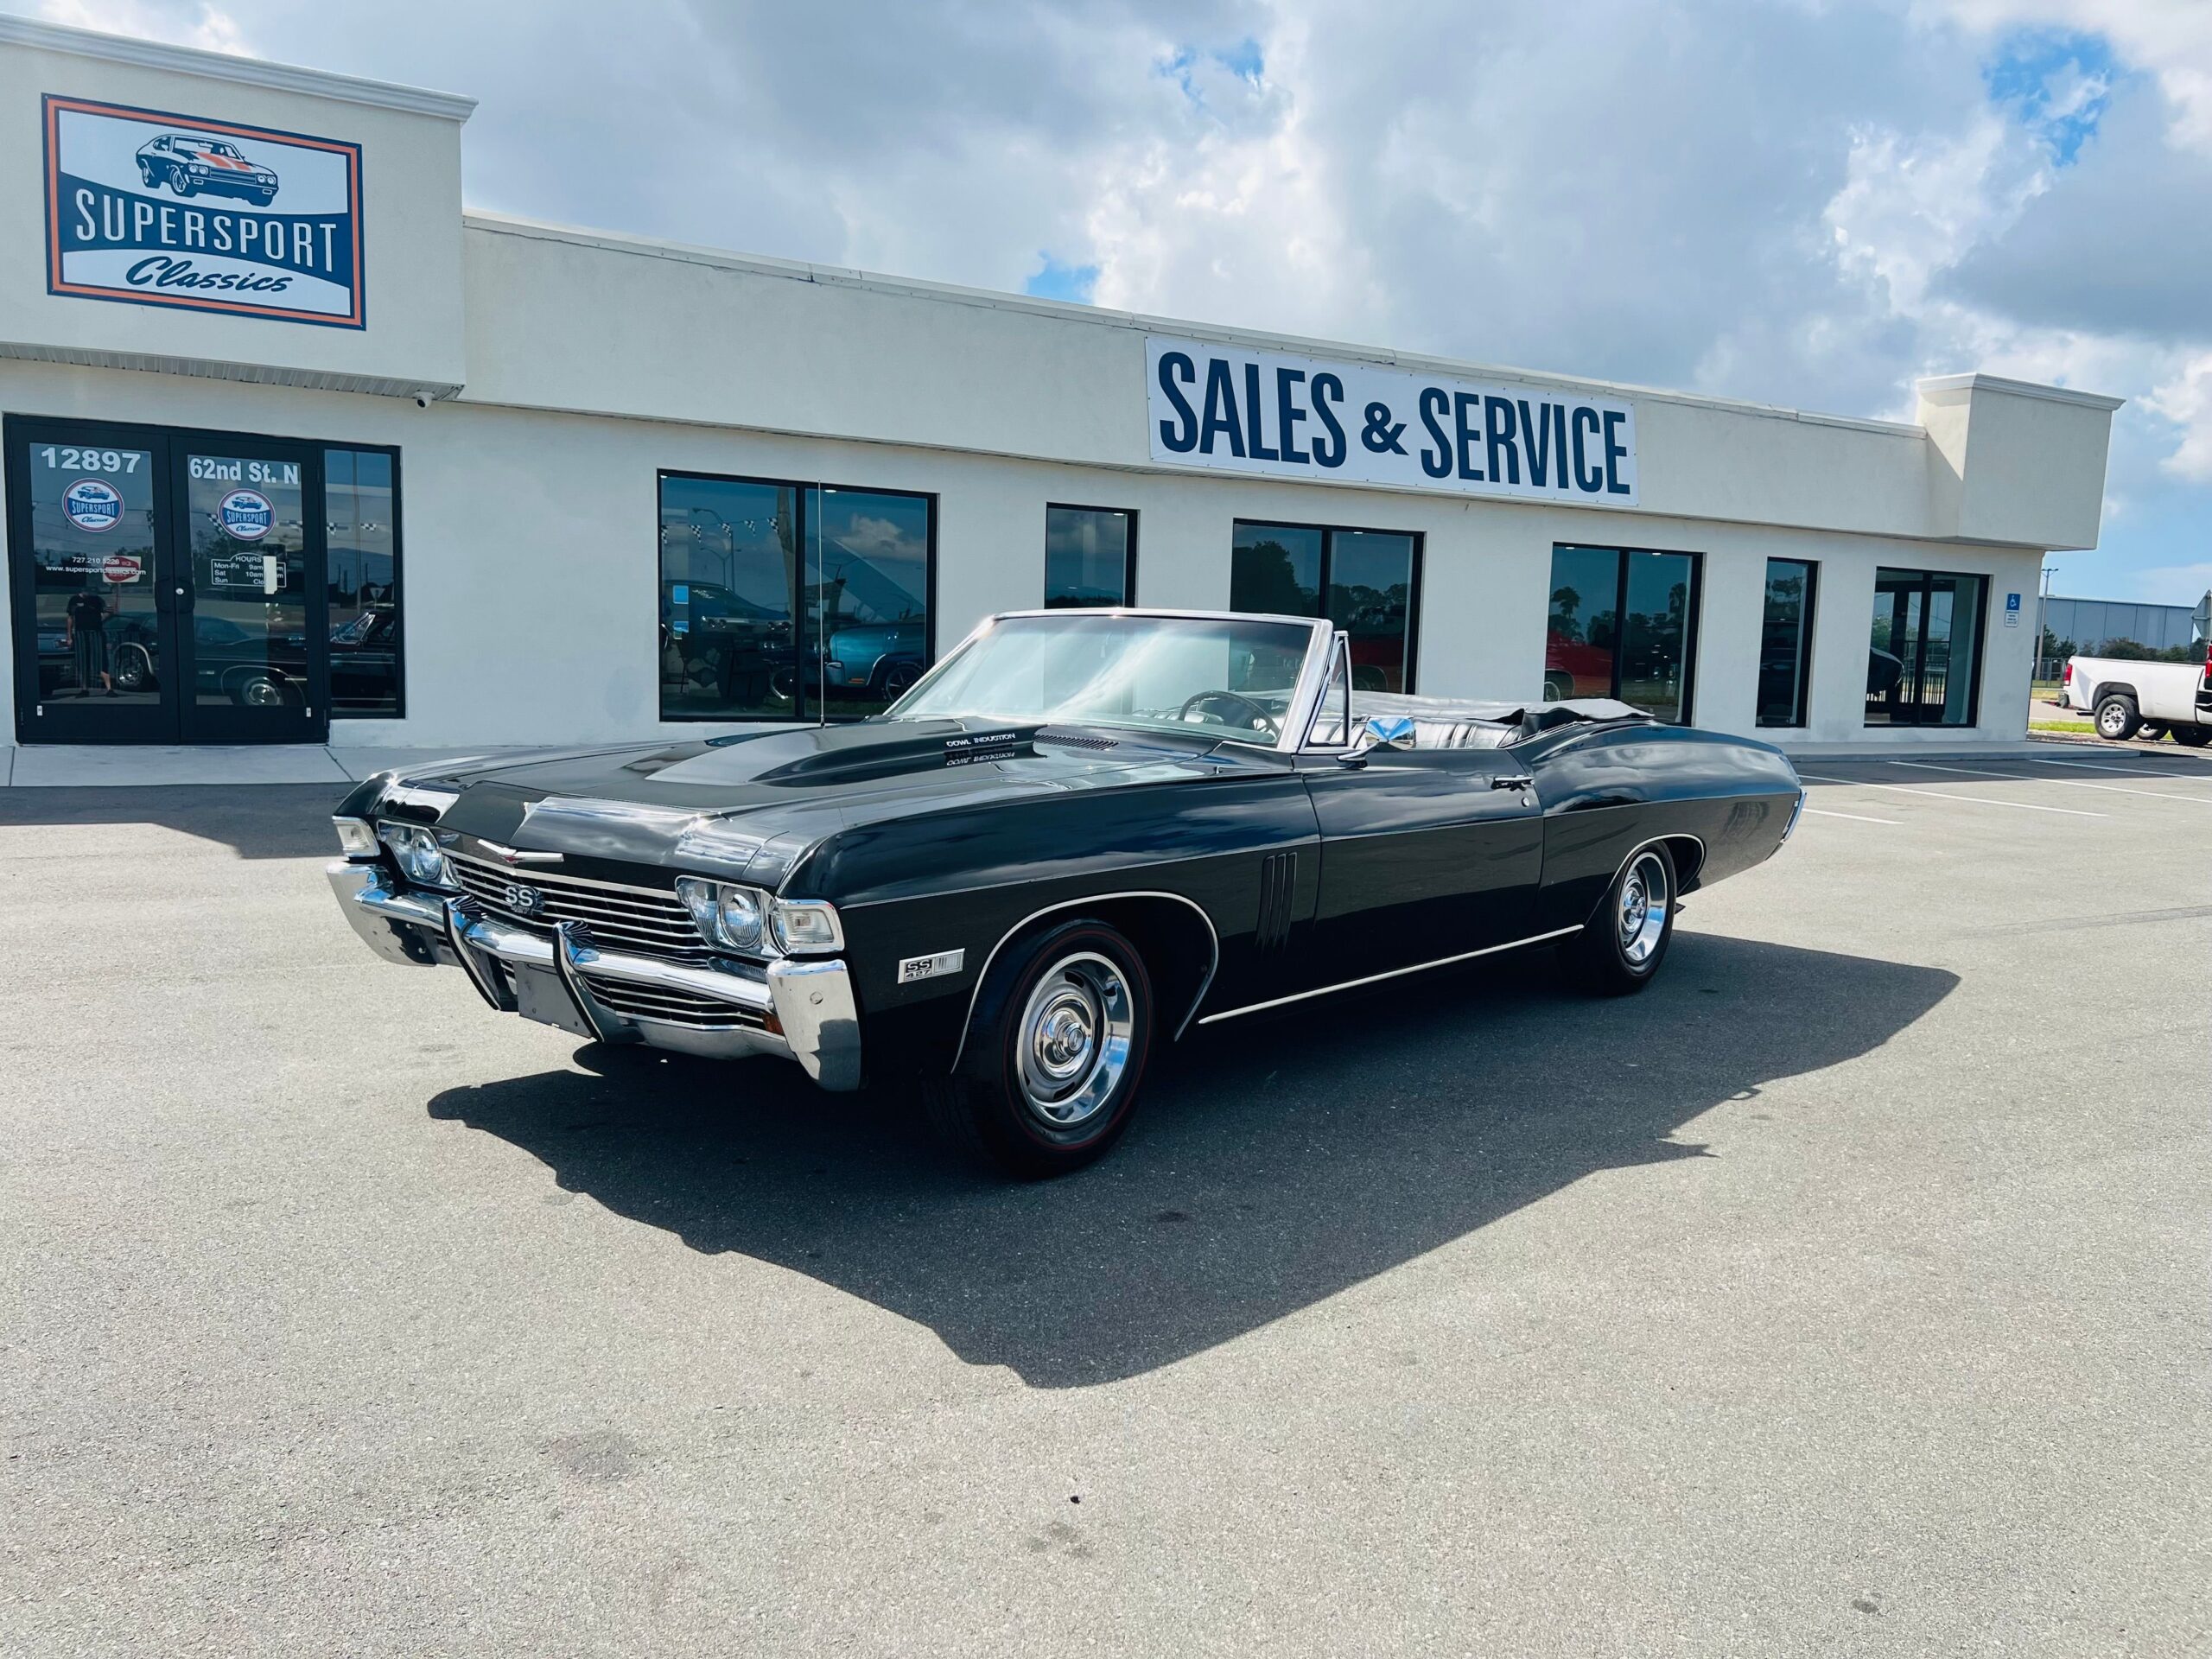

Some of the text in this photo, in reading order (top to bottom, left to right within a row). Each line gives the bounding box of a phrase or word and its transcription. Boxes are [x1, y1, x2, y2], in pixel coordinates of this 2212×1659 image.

[76, 188, 337, 272] SUPERSPORT
[125, 256, 293, 292] Classics
[1158, 351, 1630, 495] SALES & SERVICE
[41, 447, 141, 474] 12897
[190, 458, 298, 485] 62nd St. N
[72, 500, 115, 517] SUPERSPORT
[226, 511, 267, 524] SUPERSPORT
[505, 887, 533, 907] SS
[907, 959, 931, 972] SS
